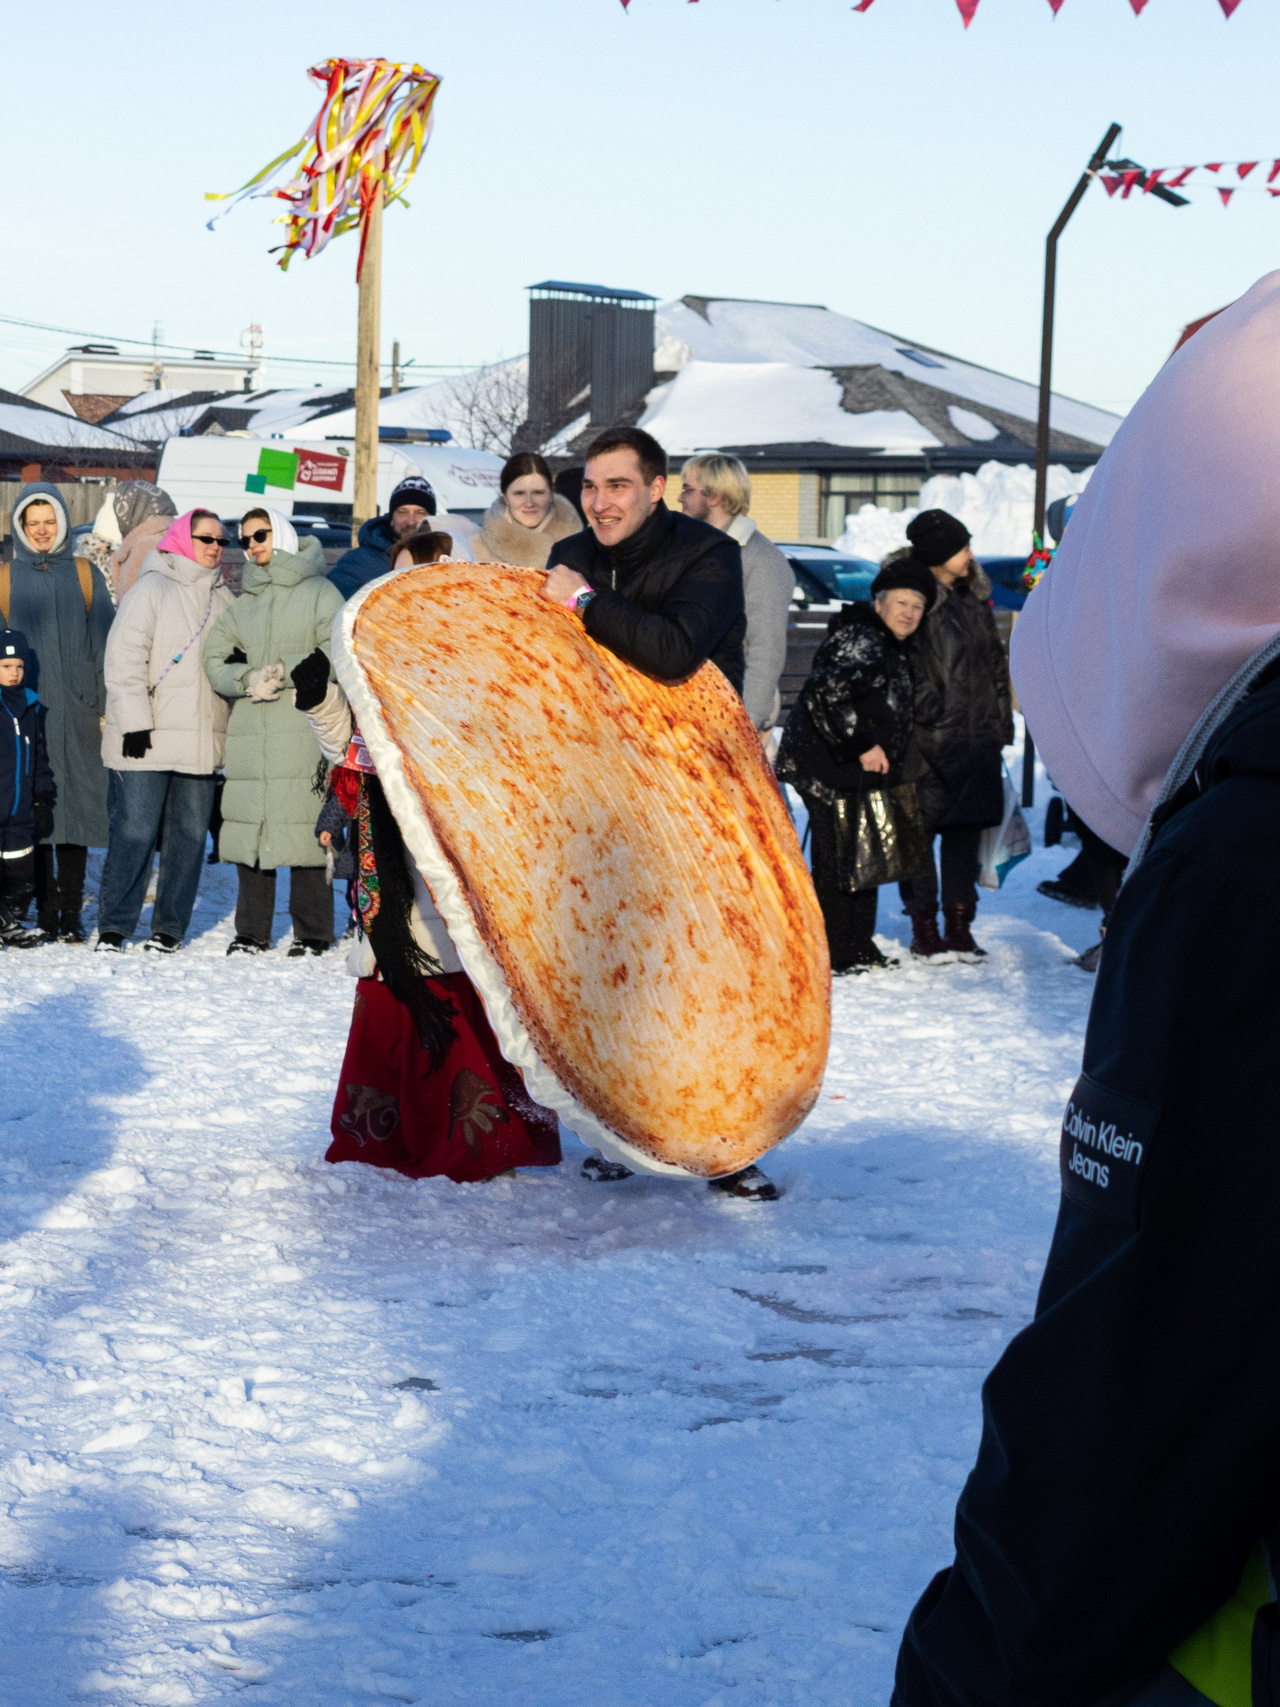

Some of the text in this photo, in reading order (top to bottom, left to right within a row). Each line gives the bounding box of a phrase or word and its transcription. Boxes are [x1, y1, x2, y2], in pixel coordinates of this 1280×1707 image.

[1063, 1101, 1144, 1165] Calvin Klein
[1068, 1142, 1111, 1189] Jeans
